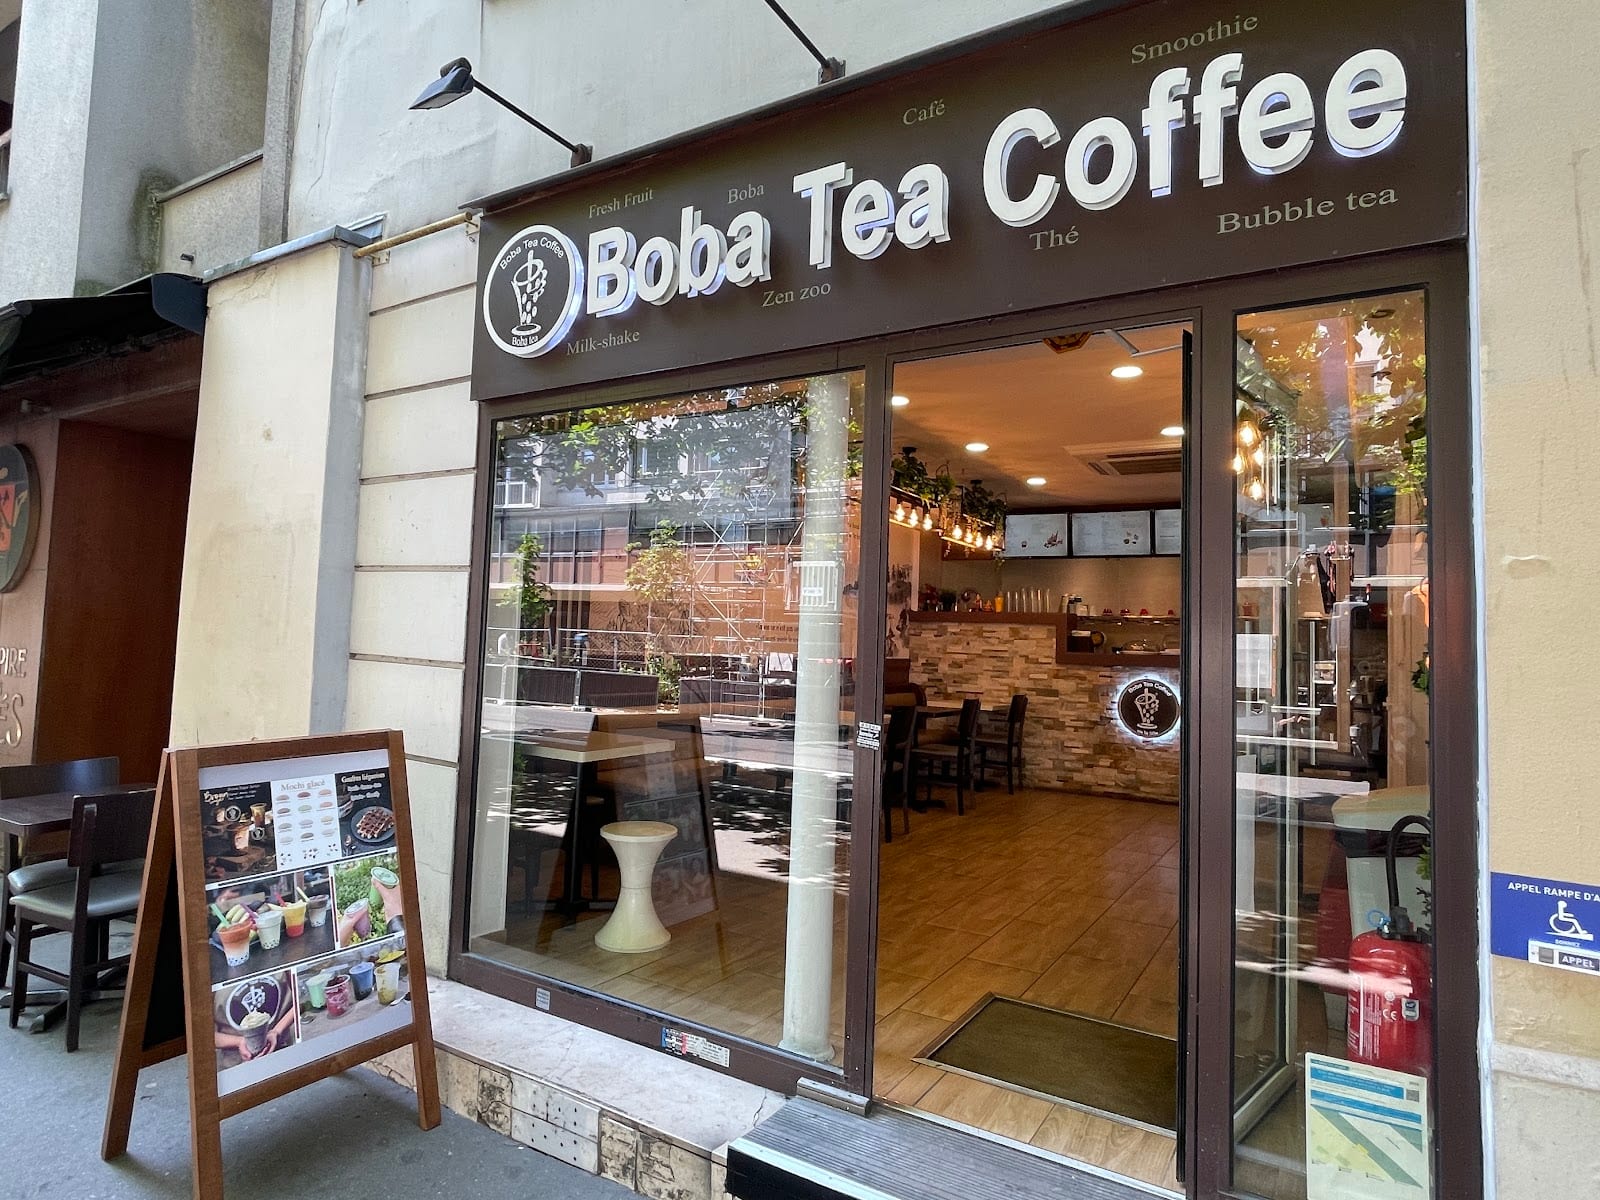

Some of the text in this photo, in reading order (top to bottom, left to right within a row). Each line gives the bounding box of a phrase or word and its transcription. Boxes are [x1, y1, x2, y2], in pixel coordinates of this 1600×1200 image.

[1131, 15, 1259, 64] Smoothie
[902, 98, 946, 126] Café
[585, 48, 1408, 317] Boba Tea Coffee
[727, 184, 765, 204] Boba
[588, 187, 655, 218] Fresh Fruit
[1216, 188, 1399, 234] Bubble tea
[1029, 225, 1080, 250] Thé
[499, 236, 565, 270] Boba Tea Coffee
[762, 282, 832, 308] Zen zoo
[566, 330, 641, 356] Milk-shake
[1507, 882, 1542, 894] APPEL
[1543, 887, 1581, 900] RAMPE
[1561, 955, 1596, 969] APPEL
